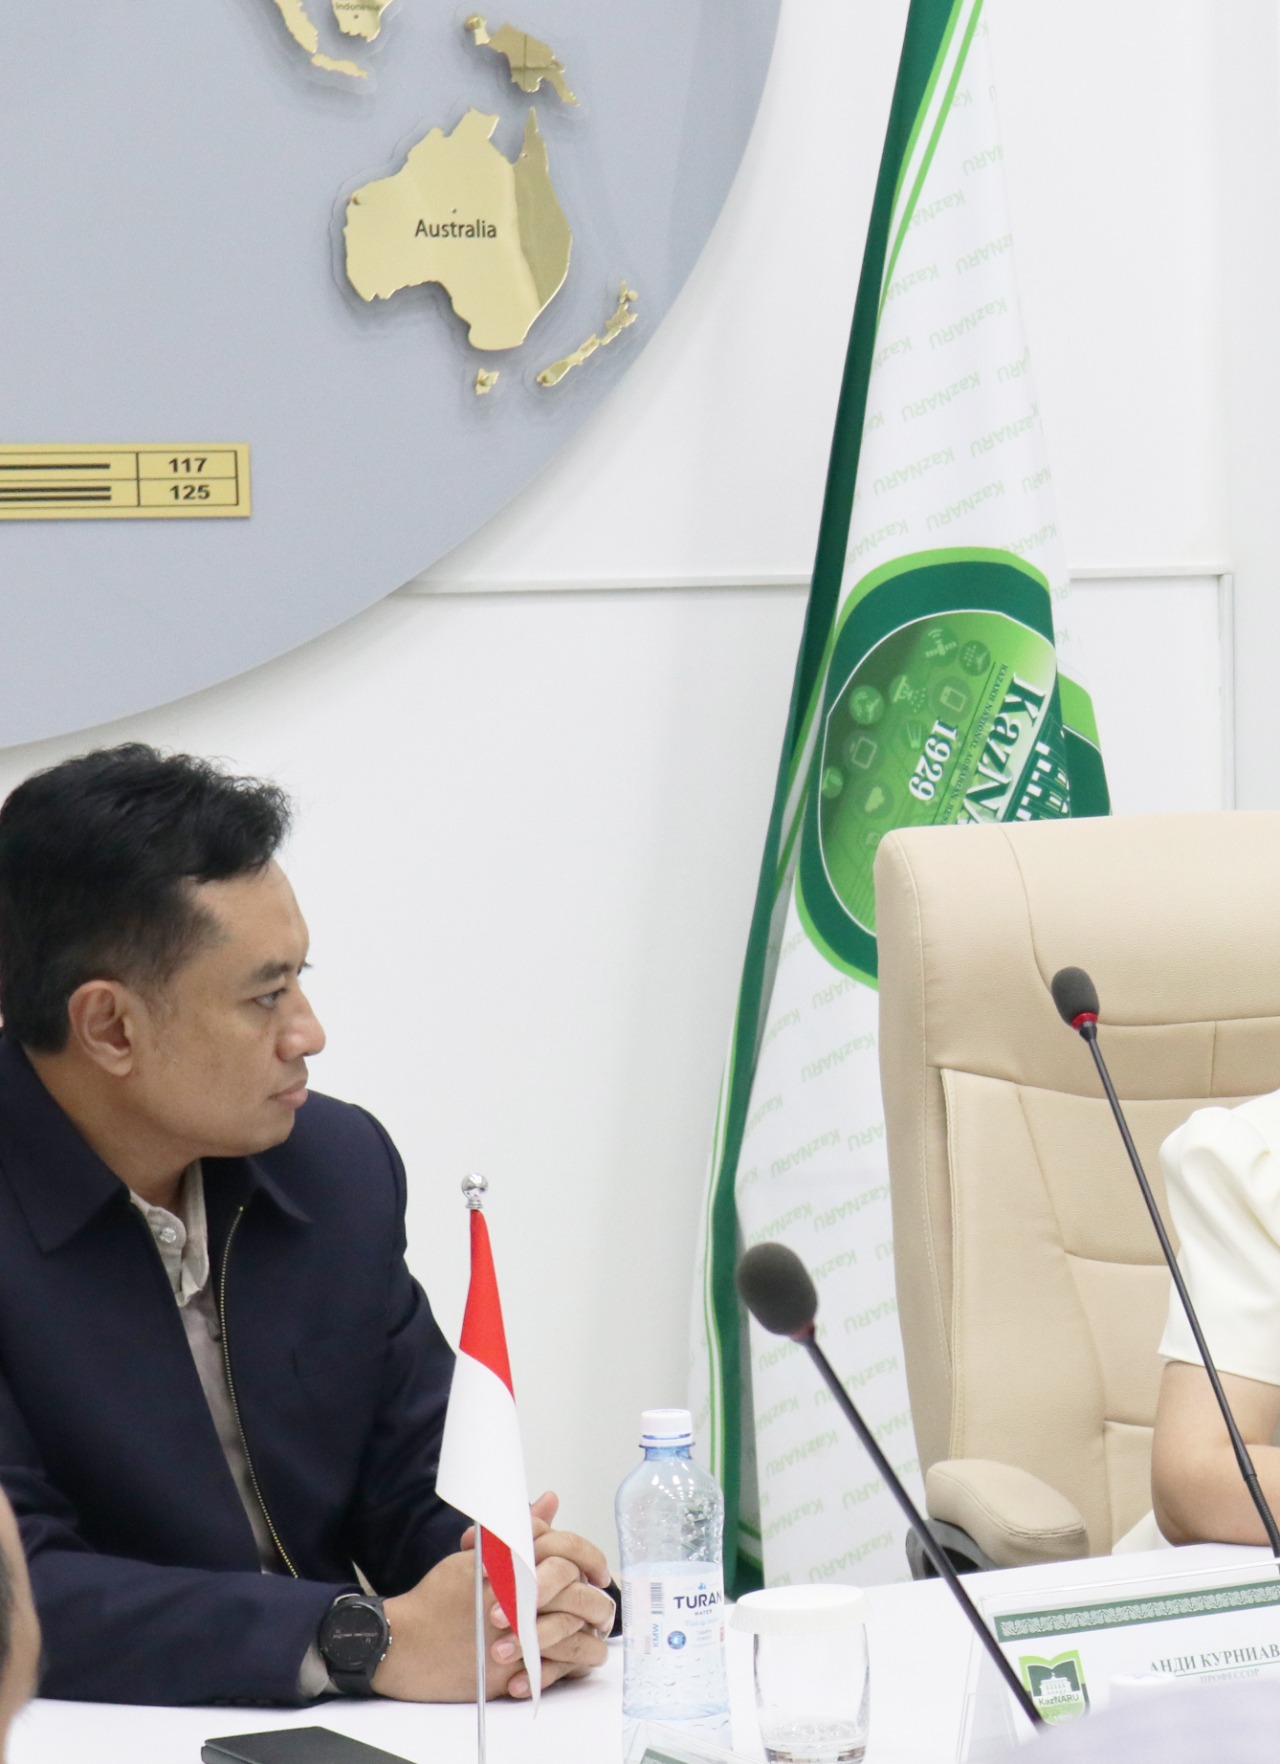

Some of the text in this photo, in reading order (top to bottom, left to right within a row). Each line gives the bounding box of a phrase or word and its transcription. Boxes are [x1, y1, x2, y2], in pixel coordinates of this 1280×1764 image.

[414, 217, 498, 240] Australia
[929, 298, 1008, 350] KazNARU
[901, 372, 981, 422] KazNARU
[168, 457, 206, 474] 117
[873, 447, 954, 496] KazNARU
[169, 484, 210, 501] 125
[926, 480, 1005, 532] KazNARU
[987, 664, 1009, 702] KAZAKH
[968, 703, 994, 749] NATIONAL
[908, 719, 960, 802] 1929
[948, 752, 975, 799] AGRARIAN
[801, 1032, 876, 1082] KazNARU
[771, 1129, 841, 1178] KazNARU
[766, 1429, 839, 1478] KazNARU
[808, 1531, 894, 1584] KazNARU
[672, 1590, 722, 1609] TURAN
[1150, 1655, 1197, 1674] АНДИ
[1039, 1694, 1079, 1705] KazNARU
